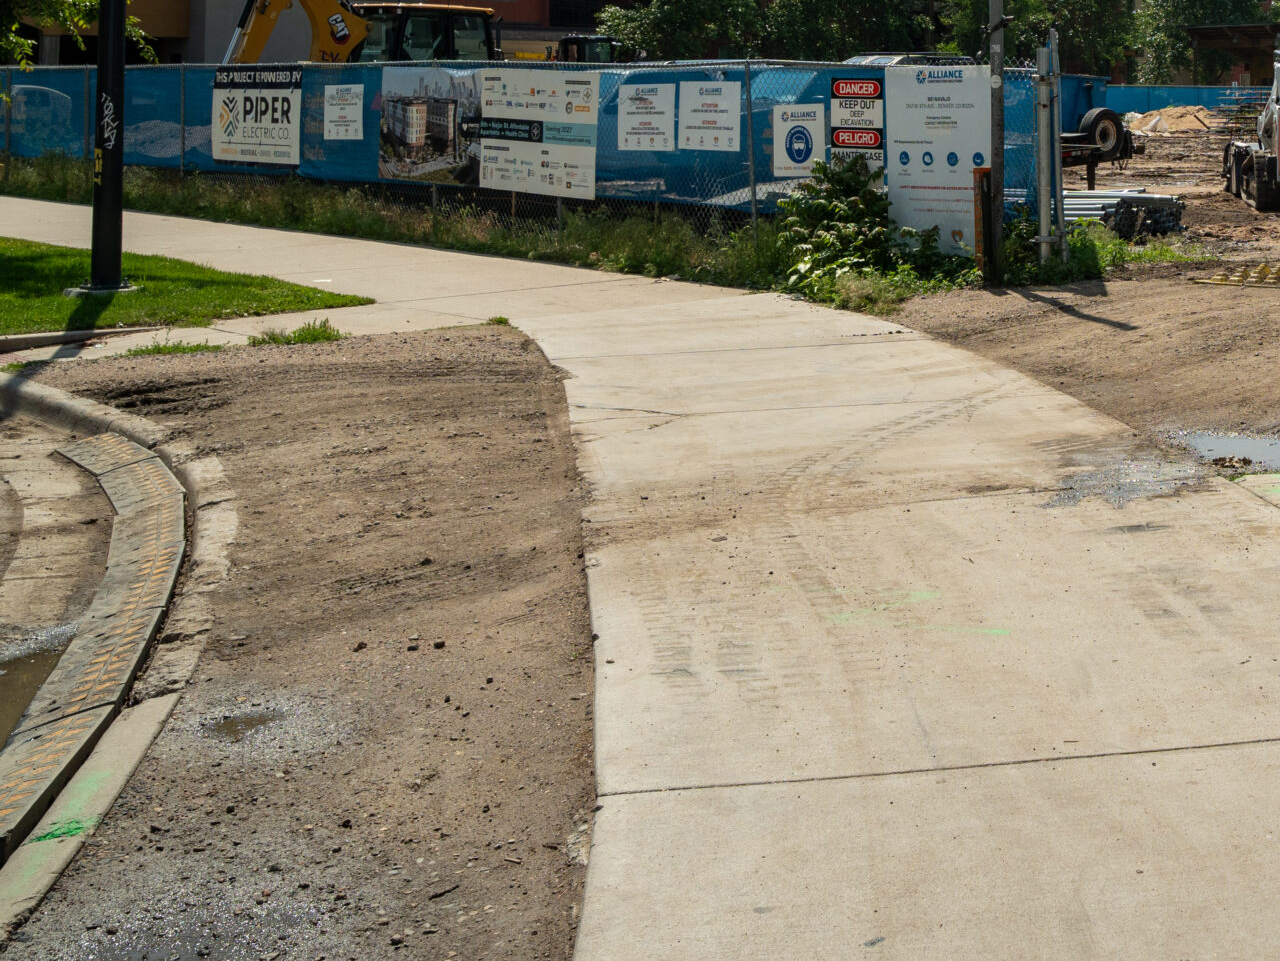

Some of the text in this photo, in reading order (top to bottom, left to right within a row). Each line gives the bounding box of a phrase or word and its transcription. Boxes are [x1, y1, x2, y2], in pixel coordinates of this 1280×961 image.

[328, 13, 350, 38] CAT
[292, 71, 302, 82] BY
[928, 69, 963, 79] ALLIANCE
[839, 83, 874, 94] DANGER
[243, 96, 291, 124] PIPER
[839, 100, 875, 109] KEEP OUT
[242, 126, 291, 140] ELECTRIC CO.
[839, 133, 874, 143] PELIGRO
